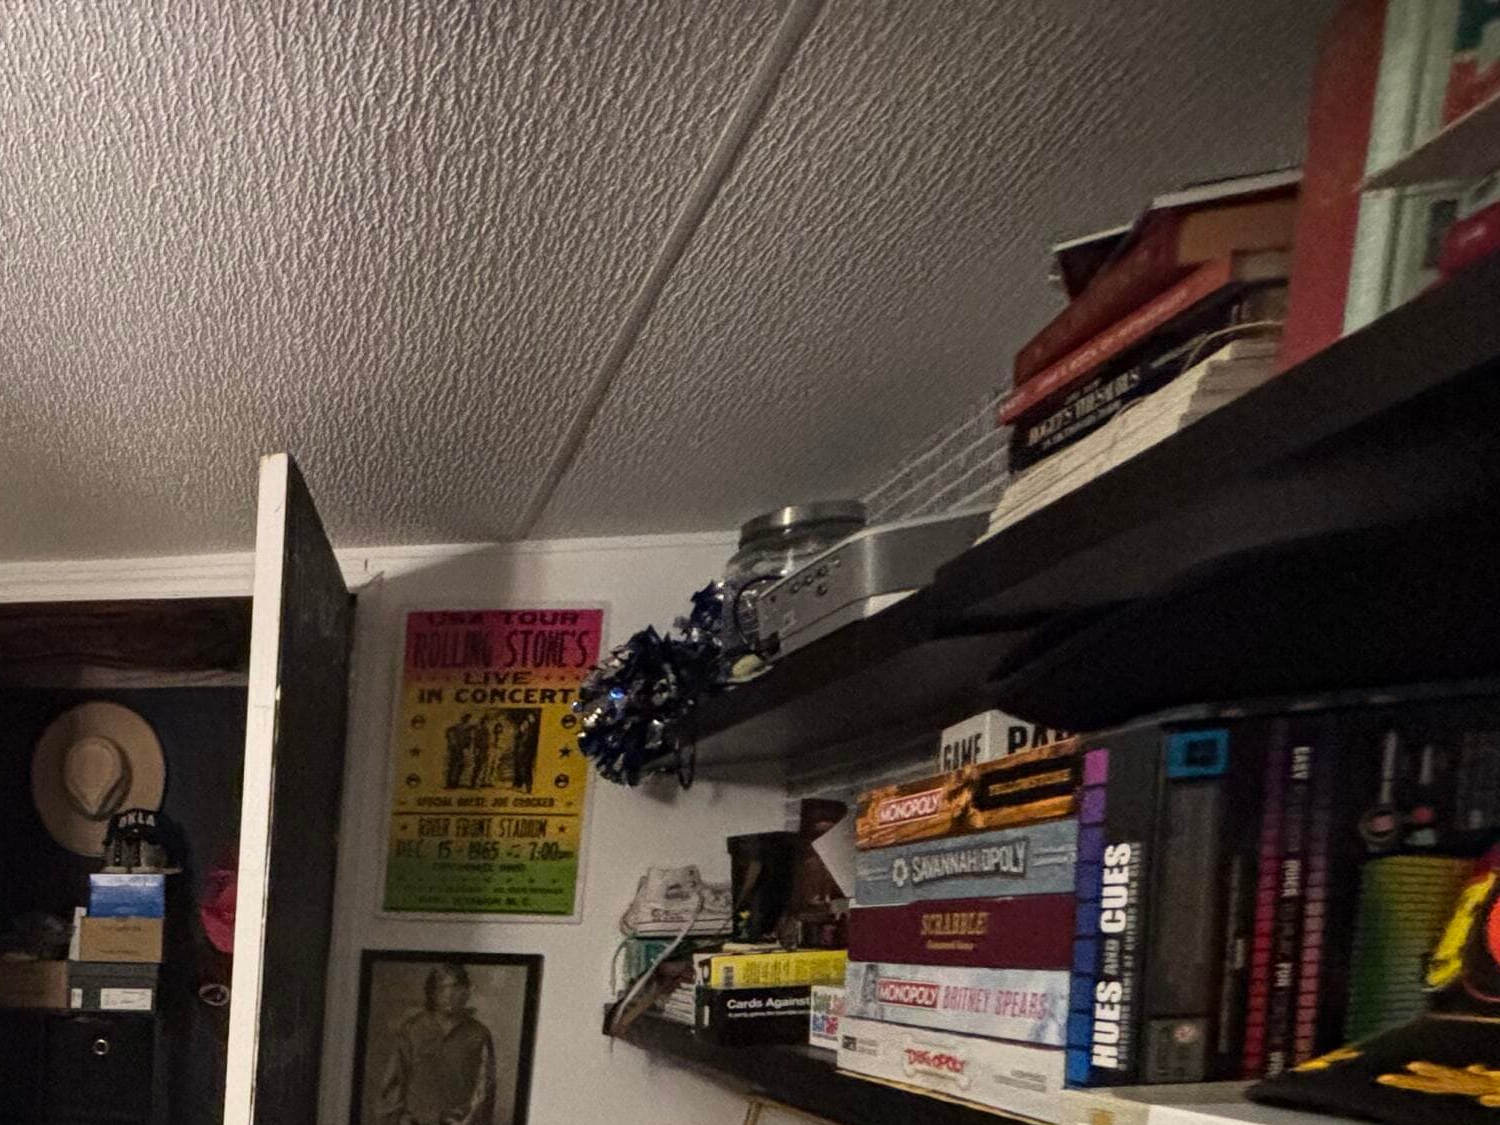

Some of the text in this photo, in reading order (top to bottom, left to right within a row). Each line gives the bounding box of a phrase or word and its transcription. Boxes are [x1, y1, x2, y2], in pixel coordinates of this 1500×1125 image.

[500, 612, 580, 626] TOUR
[412, 629, 493, 669] ROLLING
[464, 671, 533, 685] LIVE
[417, 688, 576, 705] IN CONCERT
[943, 732, 982, 771] GAME
[878, 792, 941, 823] MONOPOLY
[498, 818, 548, 838] STADIUM
[1100, 842, 1132, 934] CUES
[920, 911, 988, 936] SCRABBLE
[1103, 939, 1120, 976] AND
[726, 998, 763, 1010] Cards
[879, 981, 939, 1007] MONOPOLY
[1092, 980, 1123, 1069] HUES
